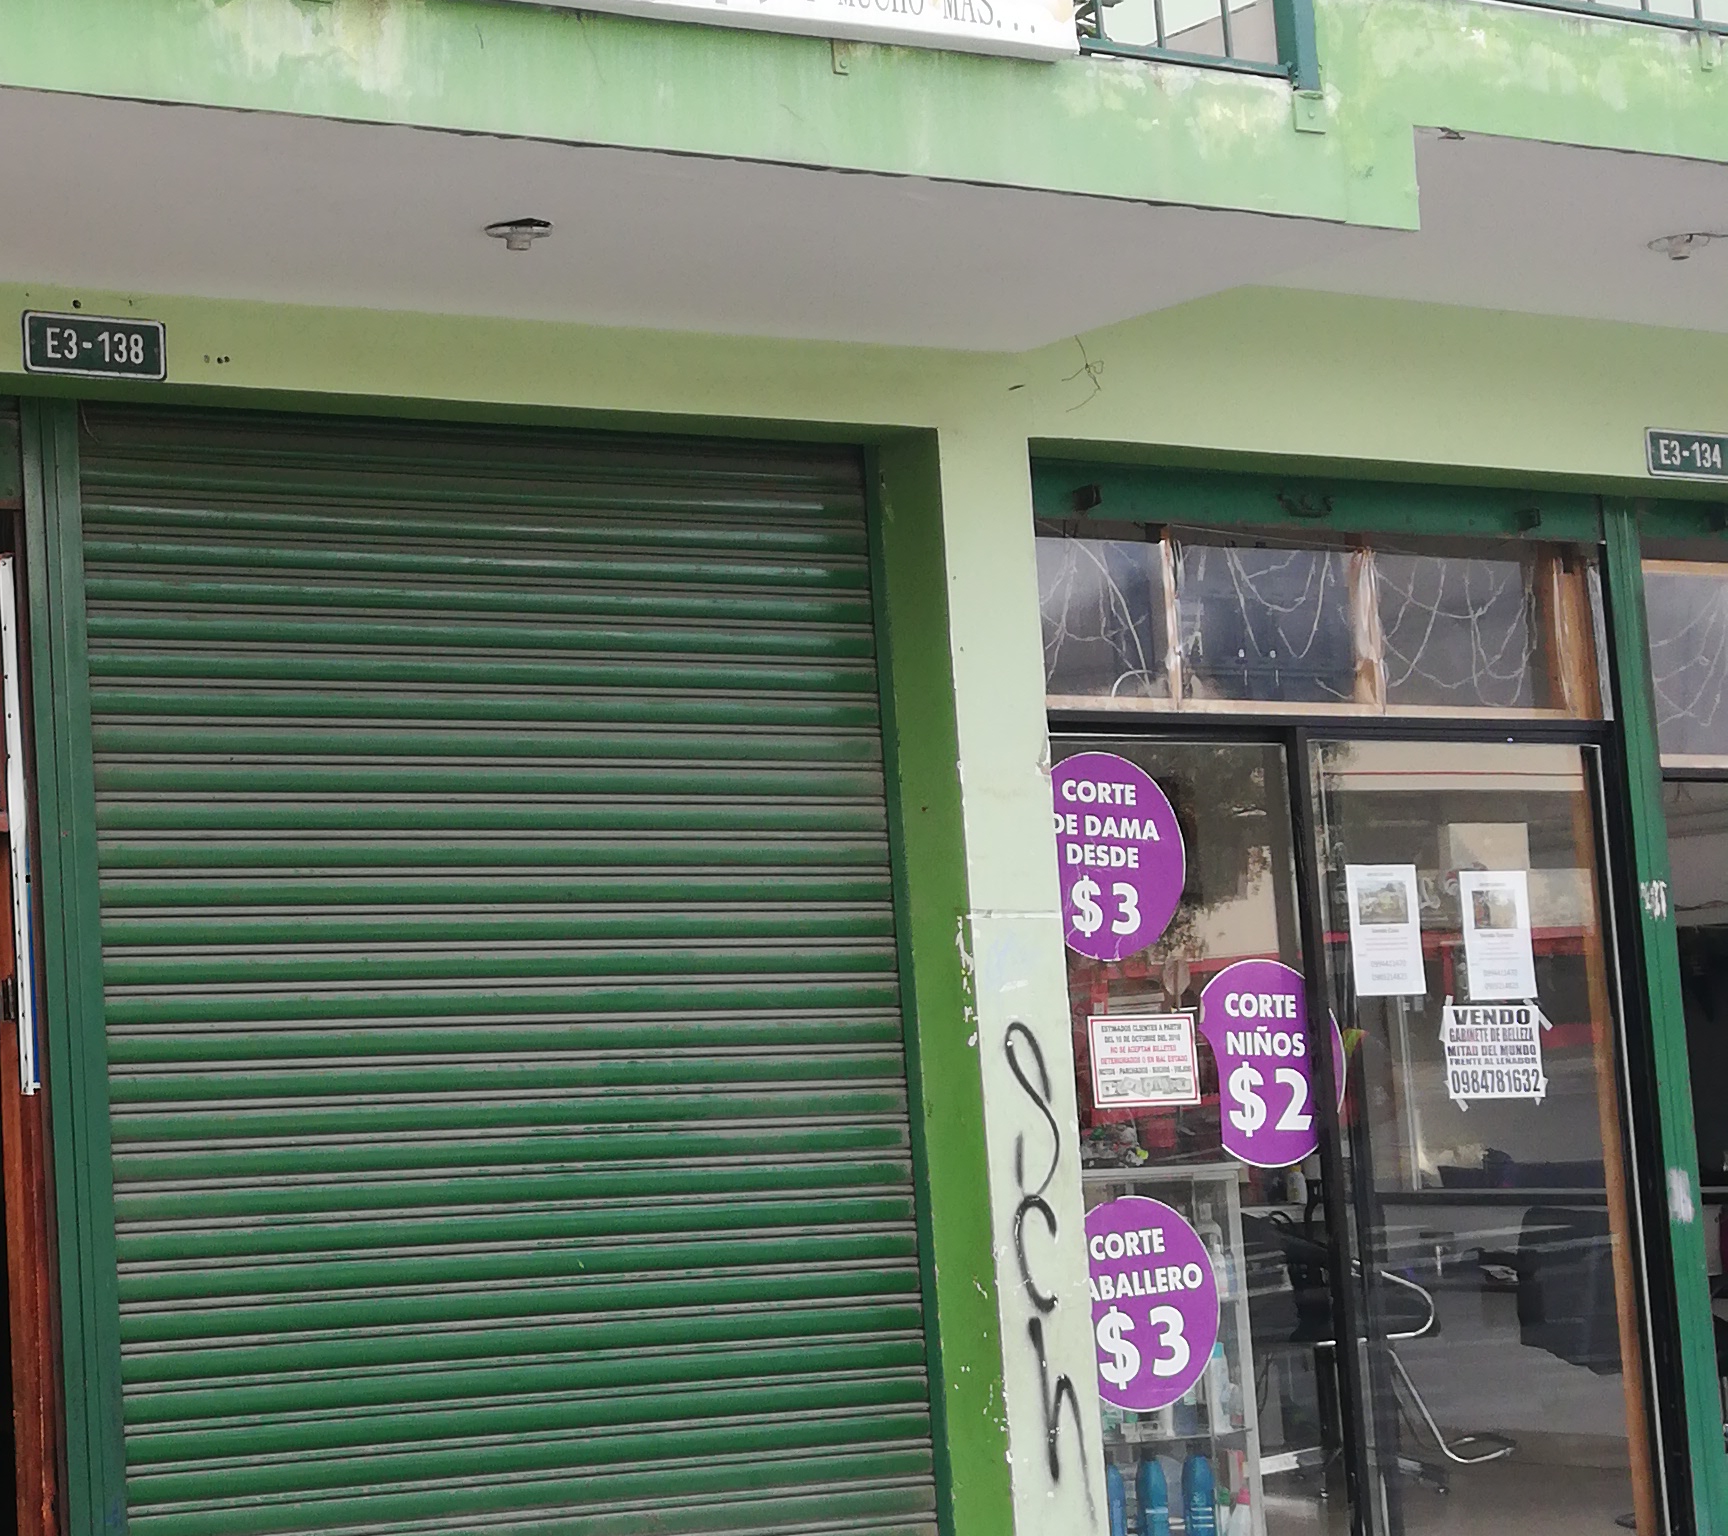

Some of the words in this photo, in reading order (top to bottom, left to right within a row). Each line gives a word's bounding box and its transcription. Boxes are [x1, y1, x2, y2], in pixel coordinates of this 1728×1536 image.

[45, 326, 145, 365] E3-138
[1658, 438, 1723, 470] E3-134
[1061, 779, 1137, 806] CORTE
[1053, 812, 1079, 836] DE
[1084, 814, 1161, 842] DAMA
[1065, 842, 1140, 869] DESDE
[1071, 874, 1142, 938] $3
[1224, 992, 1298, 1019] CORTE
[1452, 1009, 1531, 1026] VENDO
[1225, 1025, 1307, 1058] NIÑOS
[1490, 1027, 1501, 1042] DE
[1447, 1045, 1479, 1057] MITAD
[1481, 1045, 1498, 1057] DEL
[1499, 1044, 1537, 1057] MUNDO
[1451, 1069, 1541, 1094] 0984781632
[1228, 1061, 1313, 1138] $2
[1089, 1227, 1166, 1261] CORTE
[1088, 1262, 1203, 1302] ABALLERO
[1096, 1305, 1191, 1391] $3
